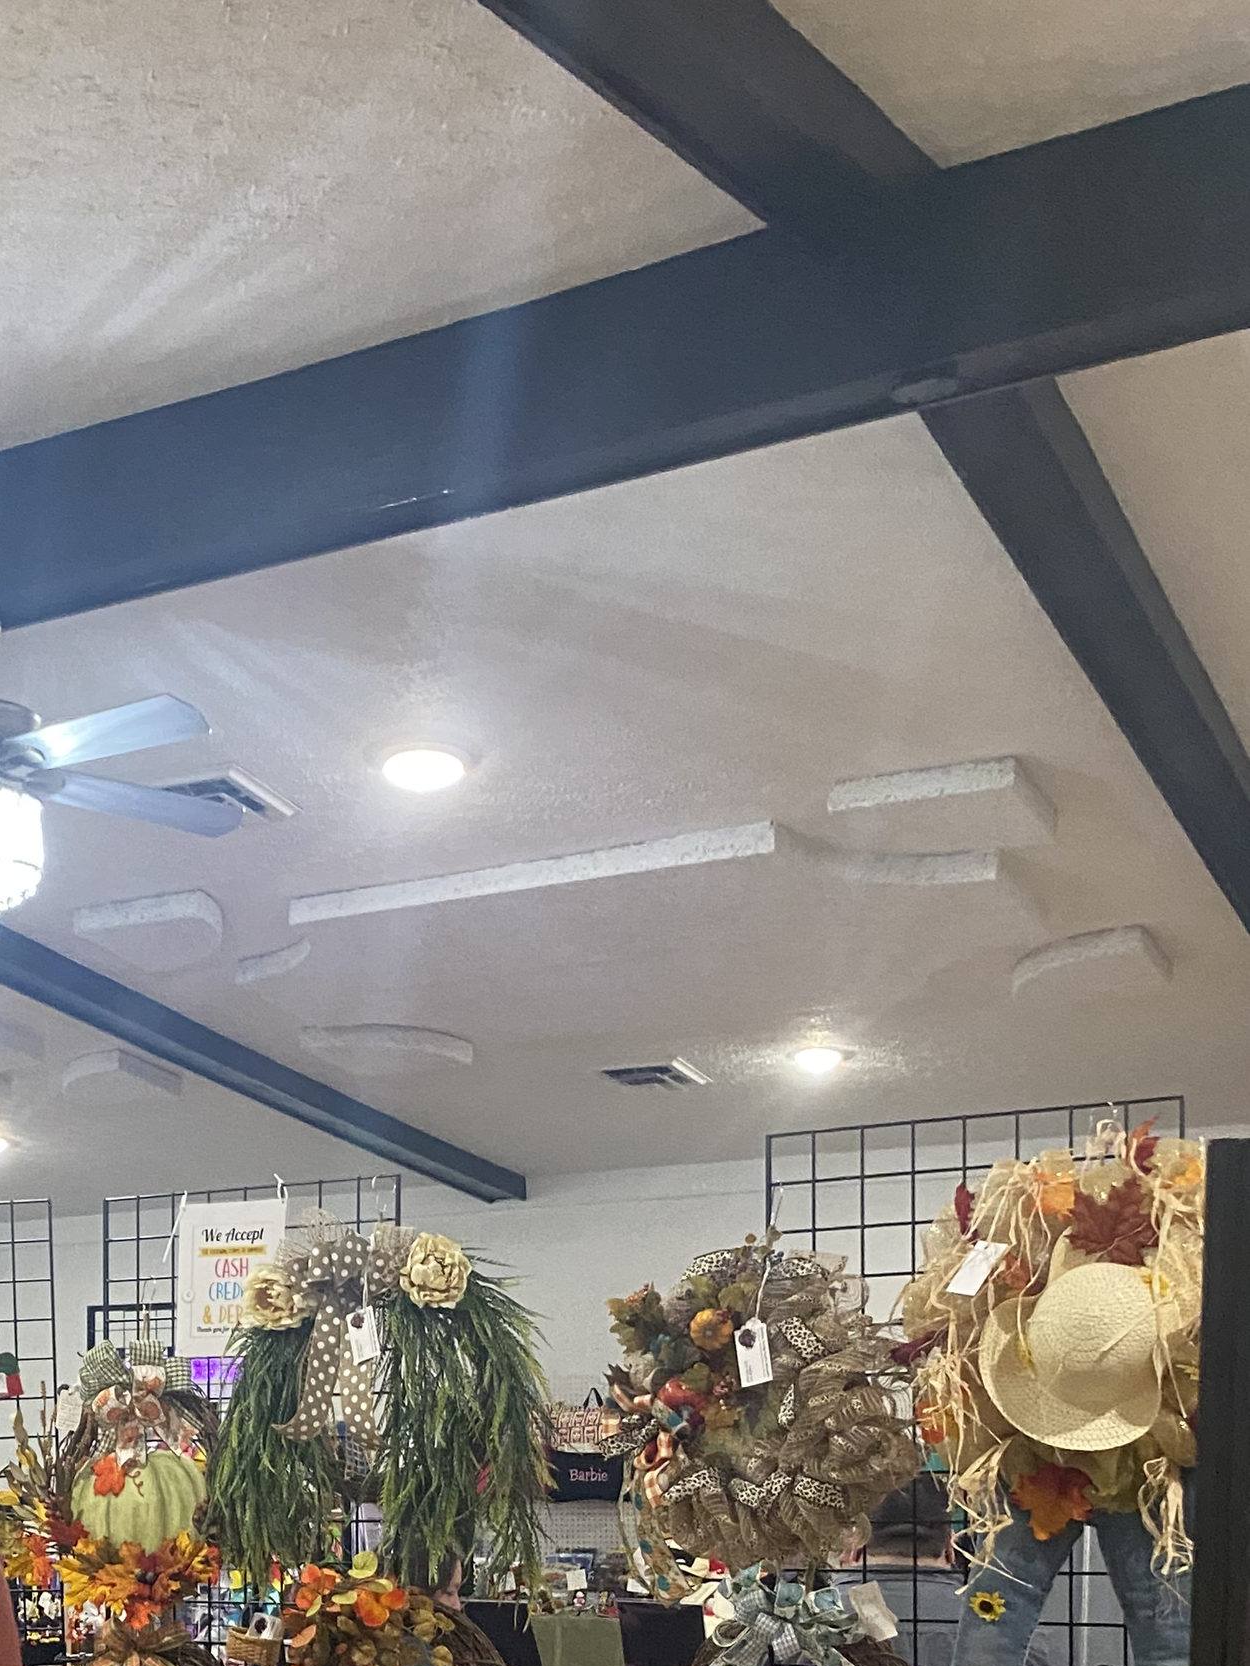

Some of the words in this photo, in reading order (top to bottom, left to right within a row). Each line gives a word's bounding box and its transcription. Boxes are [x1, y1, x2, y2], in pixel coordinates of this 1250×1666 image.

[201, 1228, 222, 1242] We
[225, 1227, 264, 1244] Accept
[214, 1258, 249, 1278] CASH
[202, 1304, 213, 1325] &
[569, 1466, 608, 1482] Barbie
